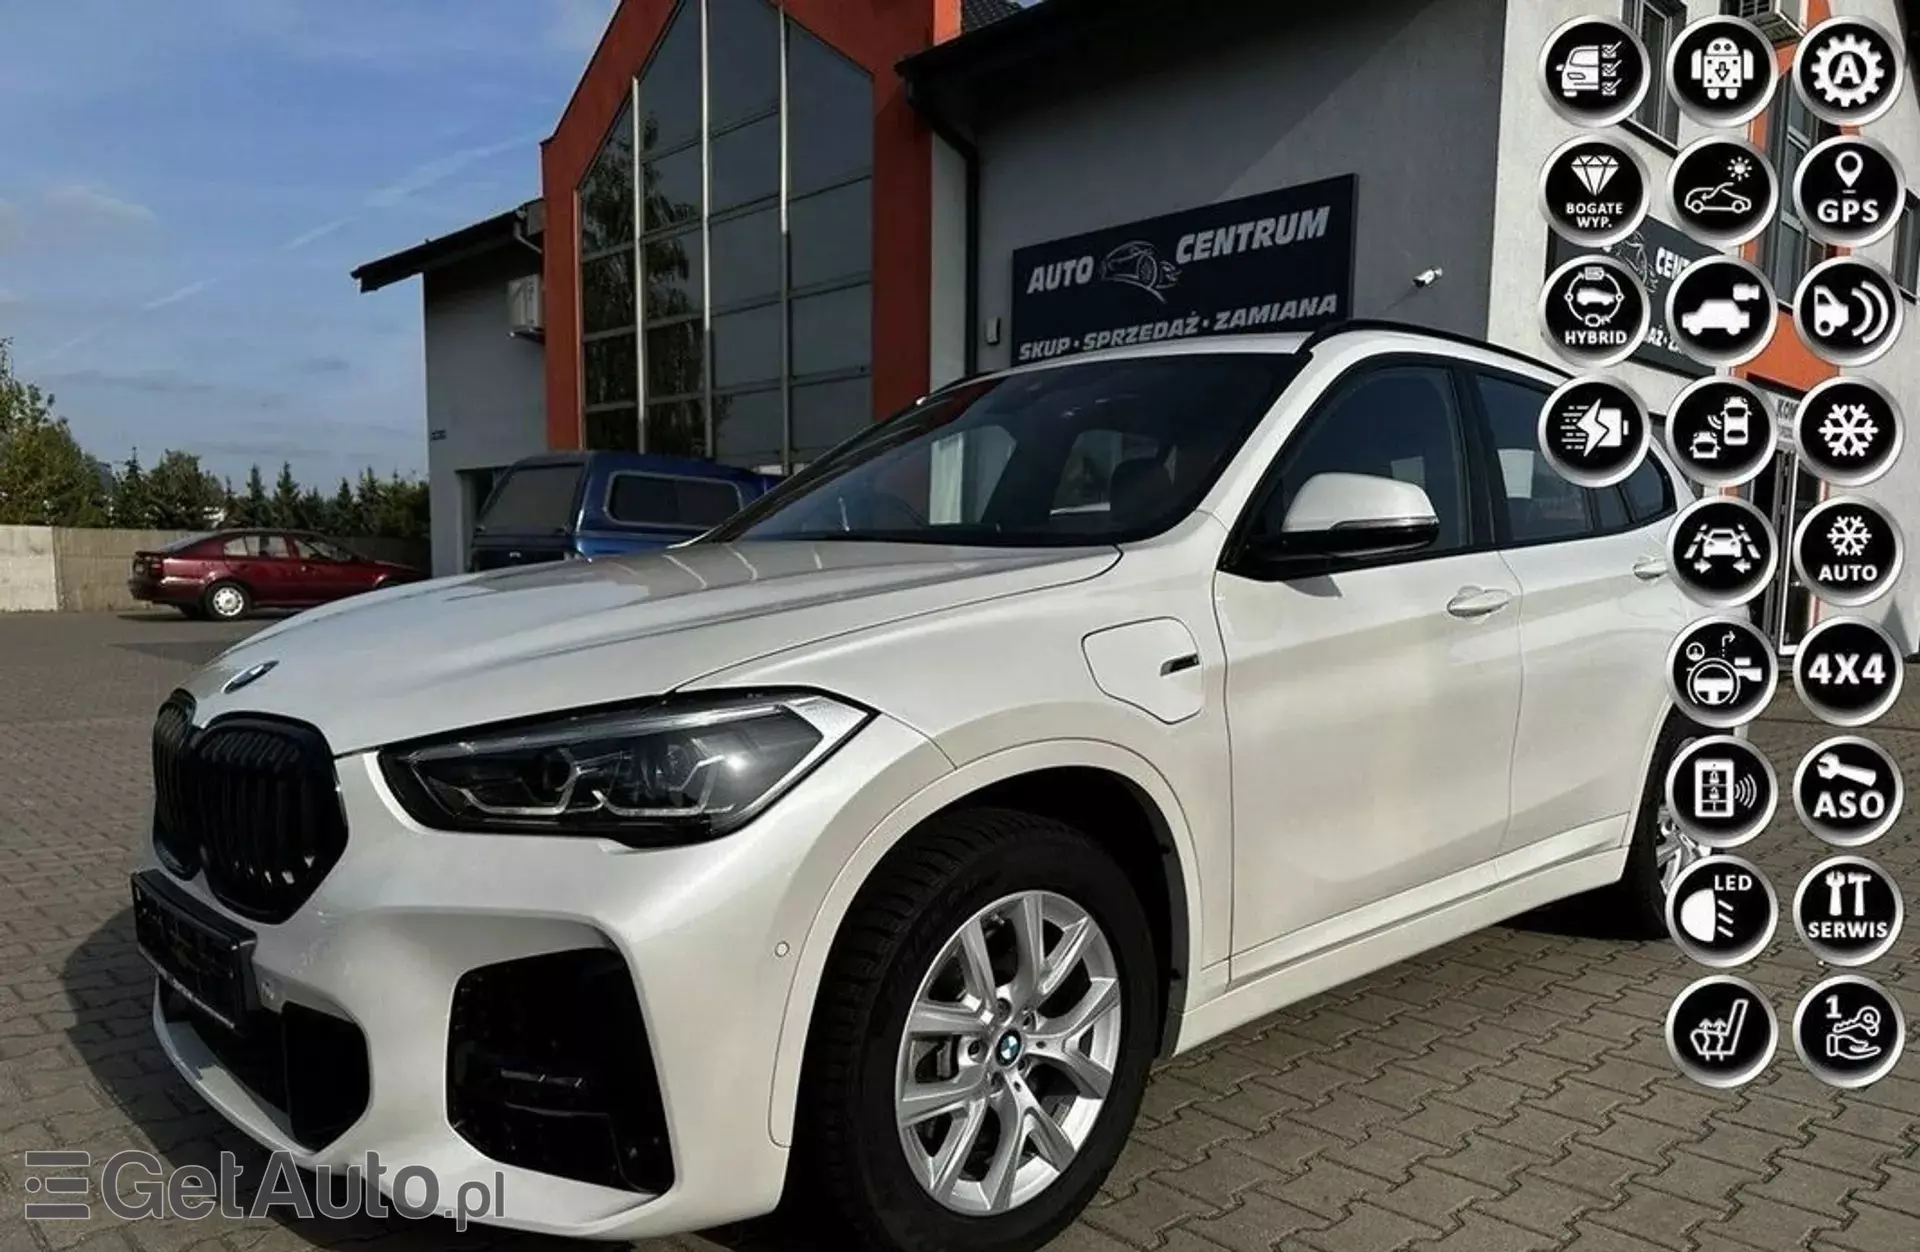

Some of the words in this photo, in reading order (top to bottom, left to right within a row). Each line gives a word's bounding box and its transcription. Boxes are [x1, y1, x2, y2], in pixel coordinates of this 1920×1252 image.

[1027, 256, 1093, 294] AUTO
[1175, 206, 1331, 264] CENTRUM
[1019, 337, 1069, 361] SKUP
[1083, 310, 1199, 351] SPRZEDAŻ
[1214, 295, 1337, 332] ZAMIANA
